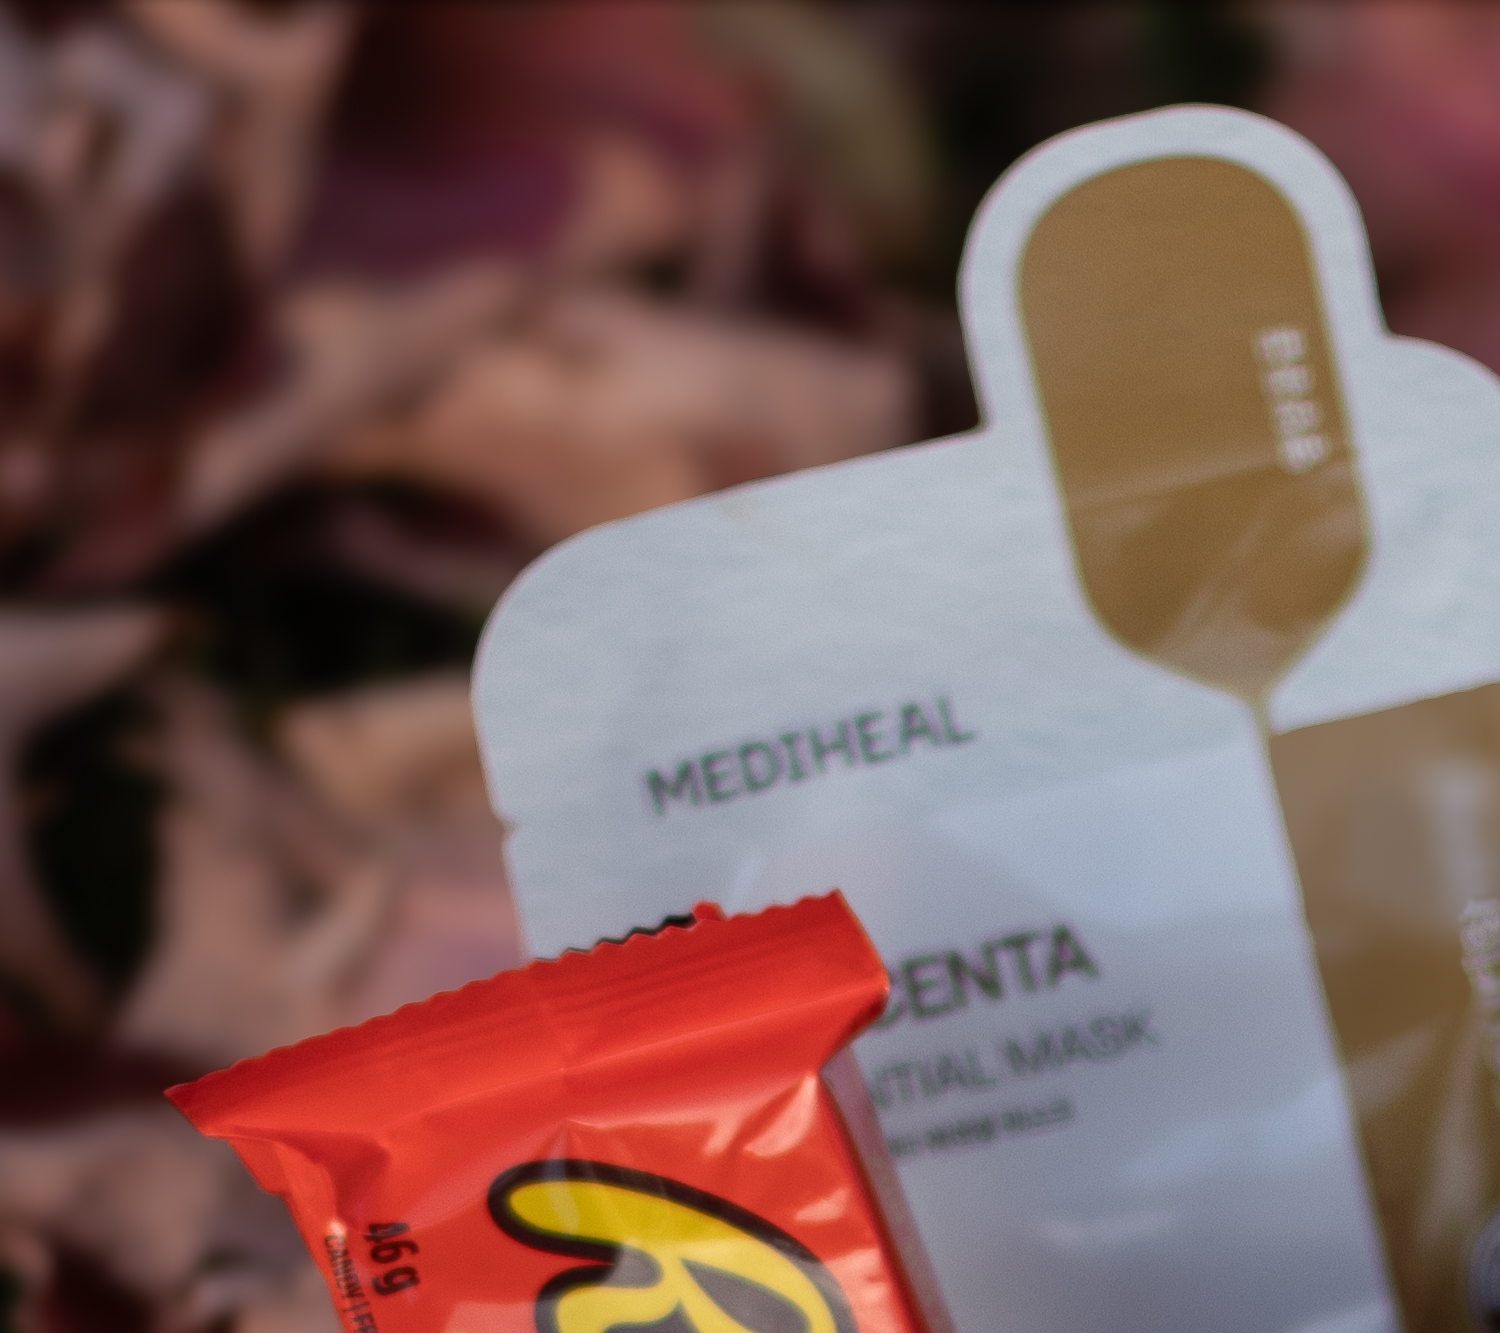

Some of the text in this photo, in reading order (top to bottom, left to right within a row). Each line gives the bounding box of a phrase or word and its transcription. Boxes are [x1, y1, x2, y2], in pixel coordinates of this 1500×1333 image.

[646, 694, 978, 816] MEDIHEAL
[1004, 1006, 1157, 1077] MASK
[325, 1235, 365, 1299] CANDY
